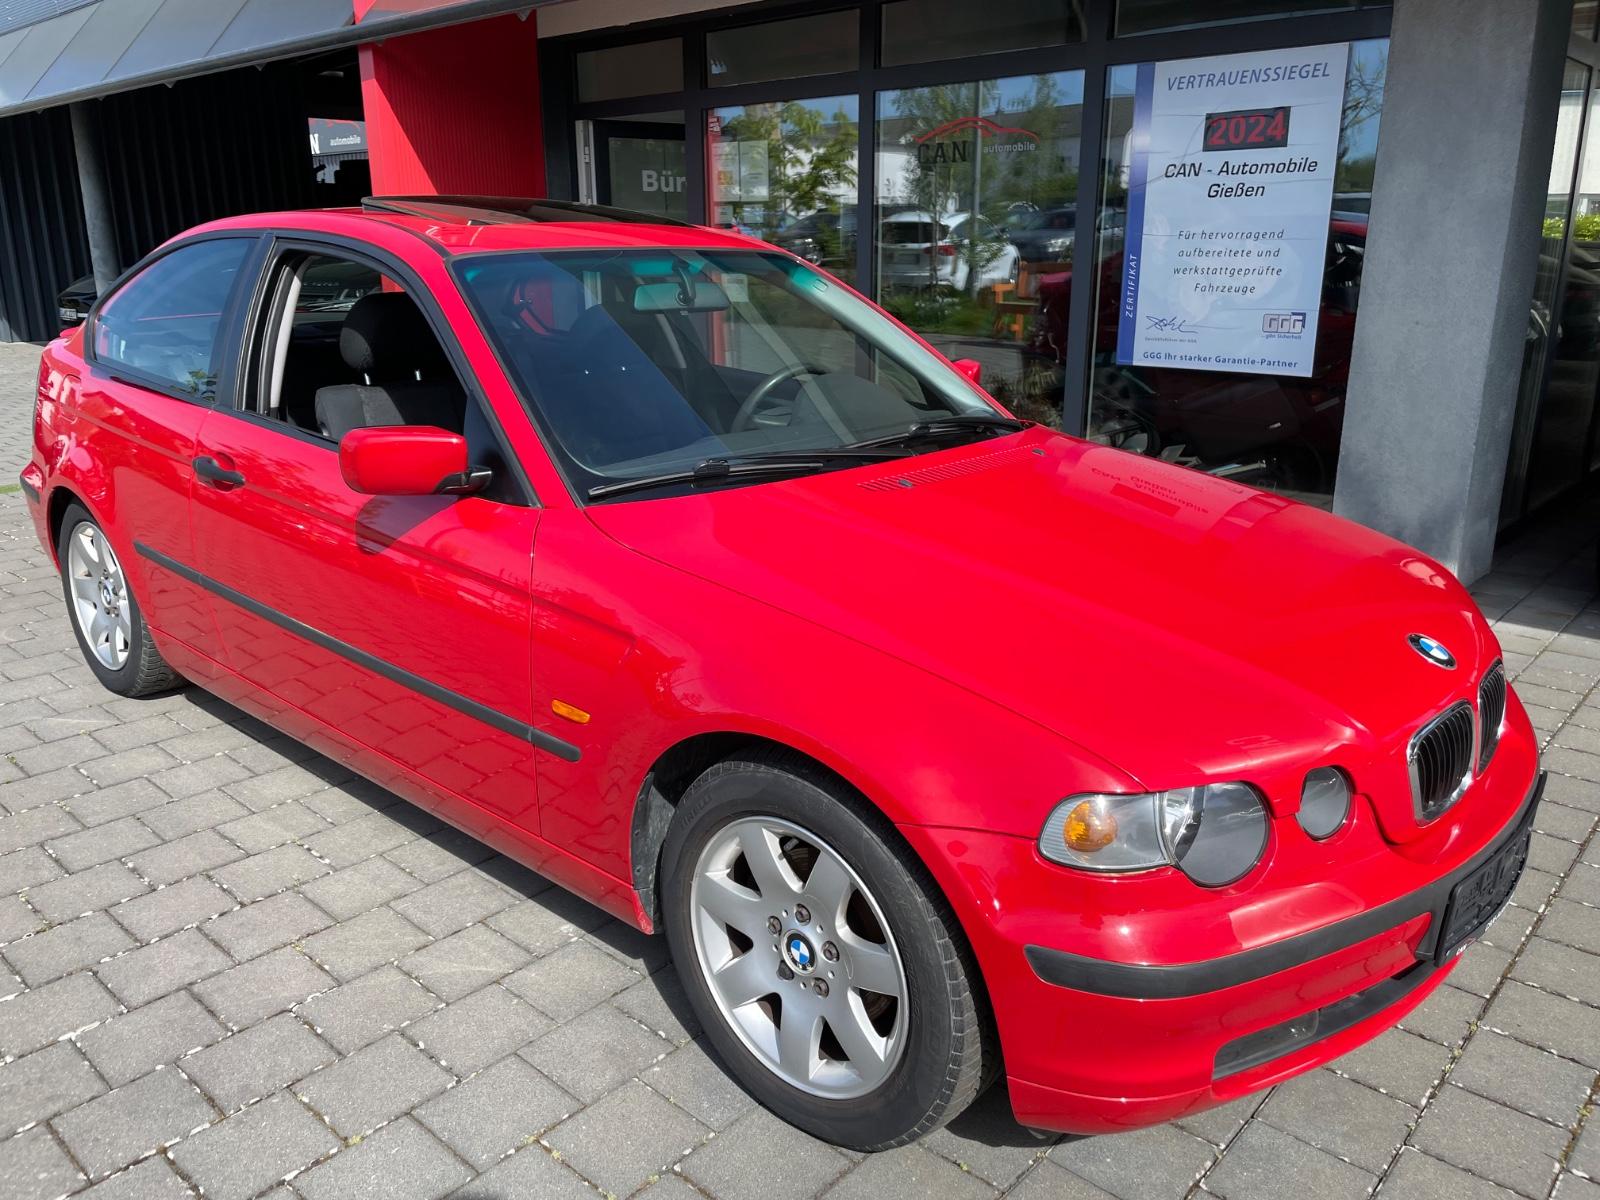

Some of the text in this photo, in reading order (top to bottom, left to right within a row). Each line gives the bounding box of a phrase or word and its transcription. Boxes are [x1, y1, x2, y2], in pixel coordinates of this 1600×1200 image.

[1167, 62, 1331, 91] VERTRAUENSSIEGEL
[1208, 111, 1287, 146] 2024
[917, 140, 1036, 164] CAN automobile
[1164, 162, 1203, 179] CAN
[1217, 157, 1319, 177] Automobile
[641, 169, 688, 192] Bür
[1207, 182, 1266, 199] Gießen
[1177, 229, 1285, 242] Für hervorragend
[1178, 247, 1281, 258] aufbereitete und
[1173, 265, 1283, 278] werkstattgeprüfte
[1125, 253, 1137, 319] ZERTIFIKAT
[1194, 282, 1256, 296] Fahrzeuge
[1143, 351, 1299, 369] GGG Ihr starker Garantie-Partner
